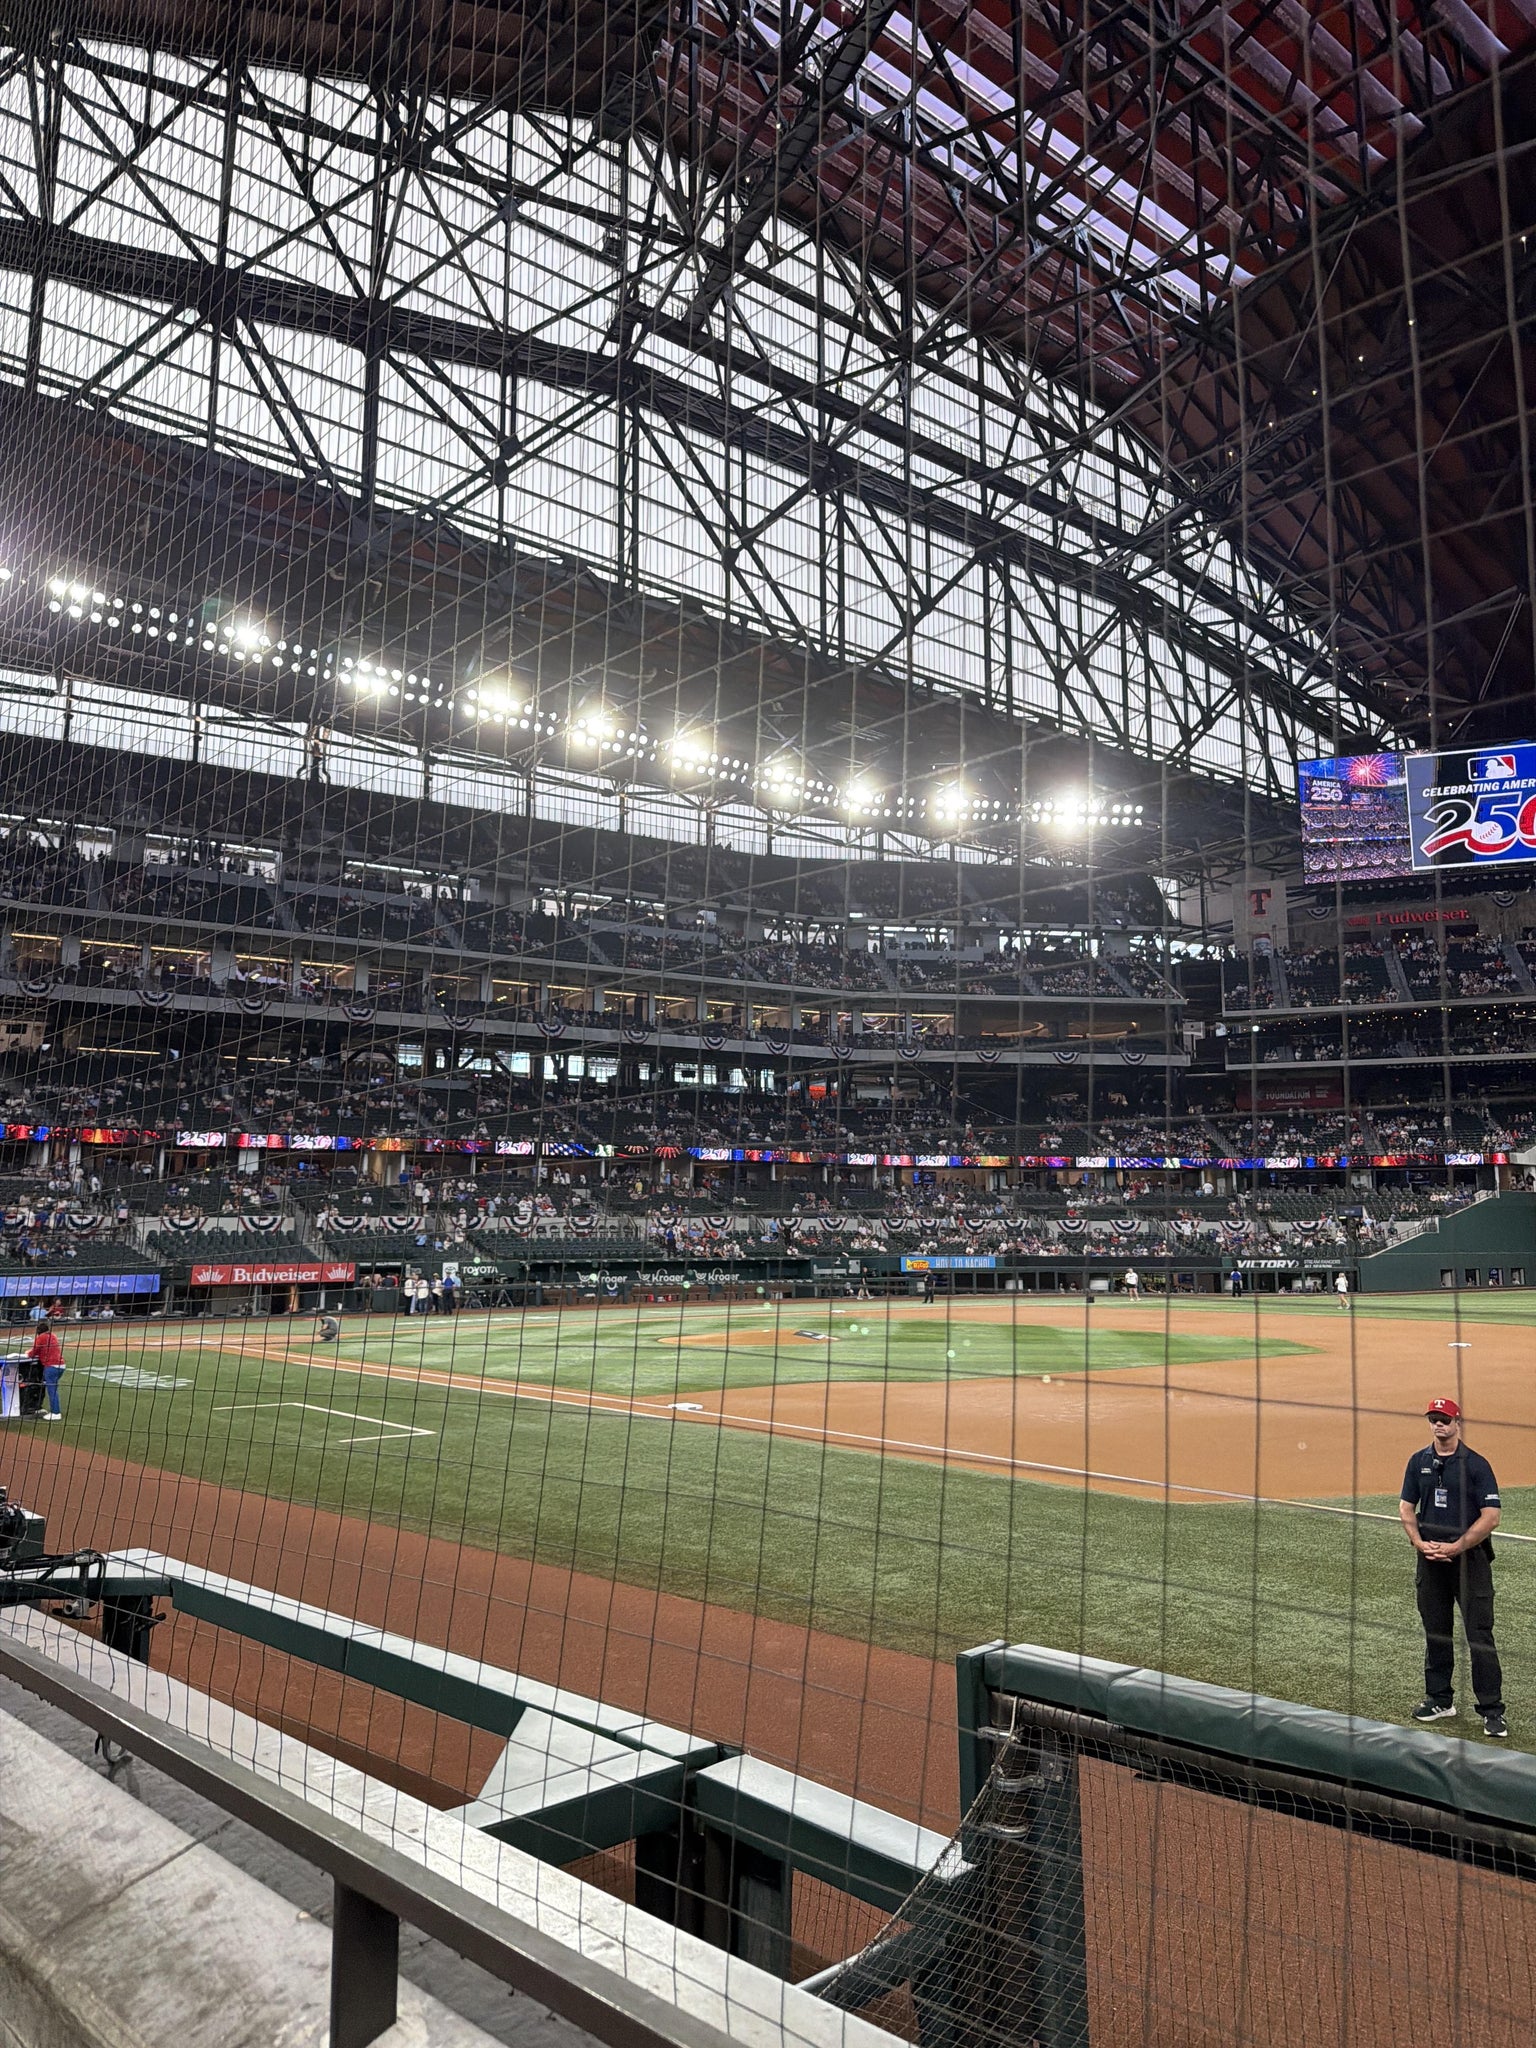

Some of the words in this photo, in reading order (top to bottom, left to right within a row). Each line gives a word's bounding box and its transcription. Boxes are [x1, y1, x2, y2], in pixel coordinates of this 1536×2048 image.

[1312, 779, 1341, 788] AMERICA
[1422, 781, 1500, 797] CELEBRATING
[1310, 786, 1343, 801] 250
[1249, 888, 1272, 917] T
[499, 1141, 532, 1155] 250
[1448, 1153, 1480, 1166] 250
[462, 1265, 499, 1275] TOYOTA
[1237, 1259, 1296, 1268] VICTORY
[233, 1267, 318, 1282] Budweiser
[651, 1268, 685, 1282] Kroger
[1434, 1399, 1446, 1409] T
